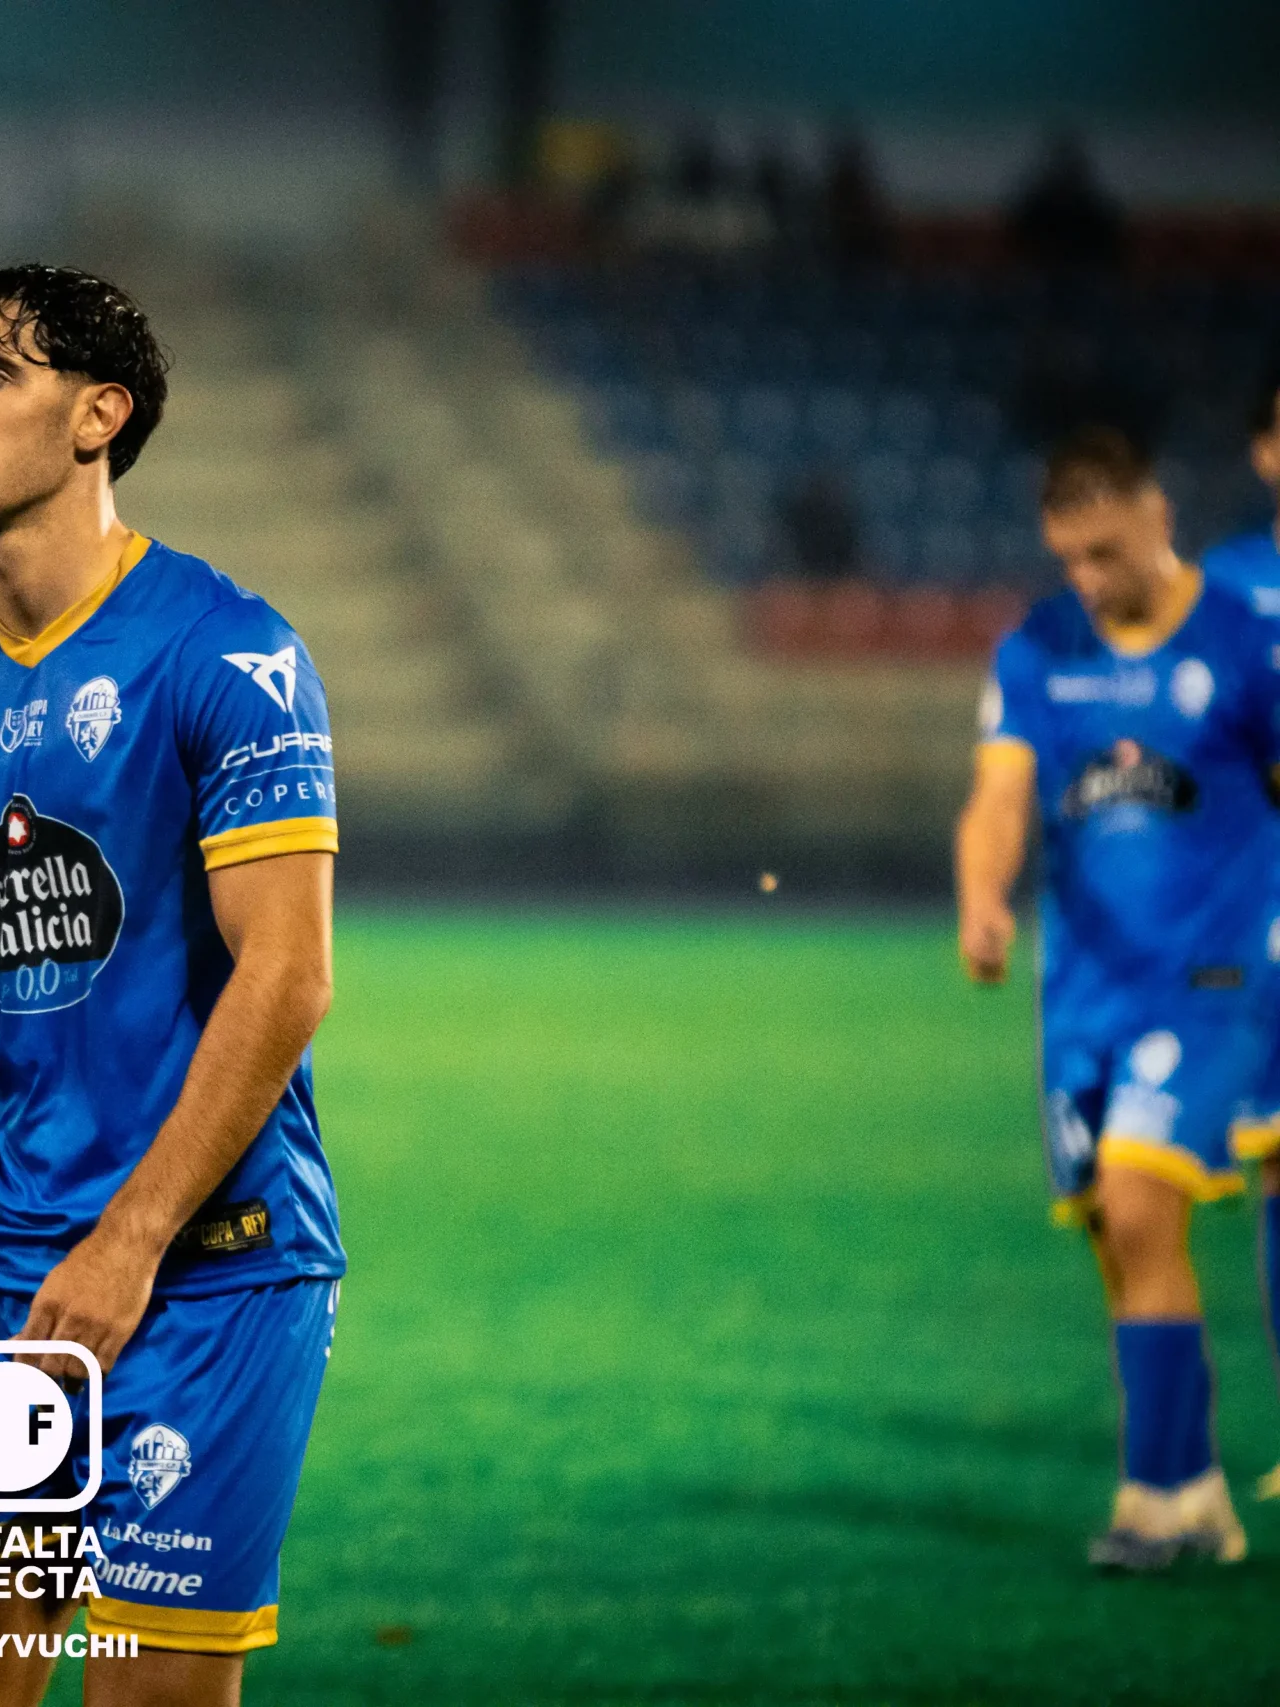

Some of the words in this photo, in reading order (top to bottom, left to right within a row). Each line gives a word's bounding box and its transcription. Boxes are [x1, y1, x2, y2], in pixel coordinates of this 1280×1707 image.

[0, 902, 93, 958] alicia
[201, 1219, 235, 1246] COPA
[241, 1211, 266, 1237] REY
